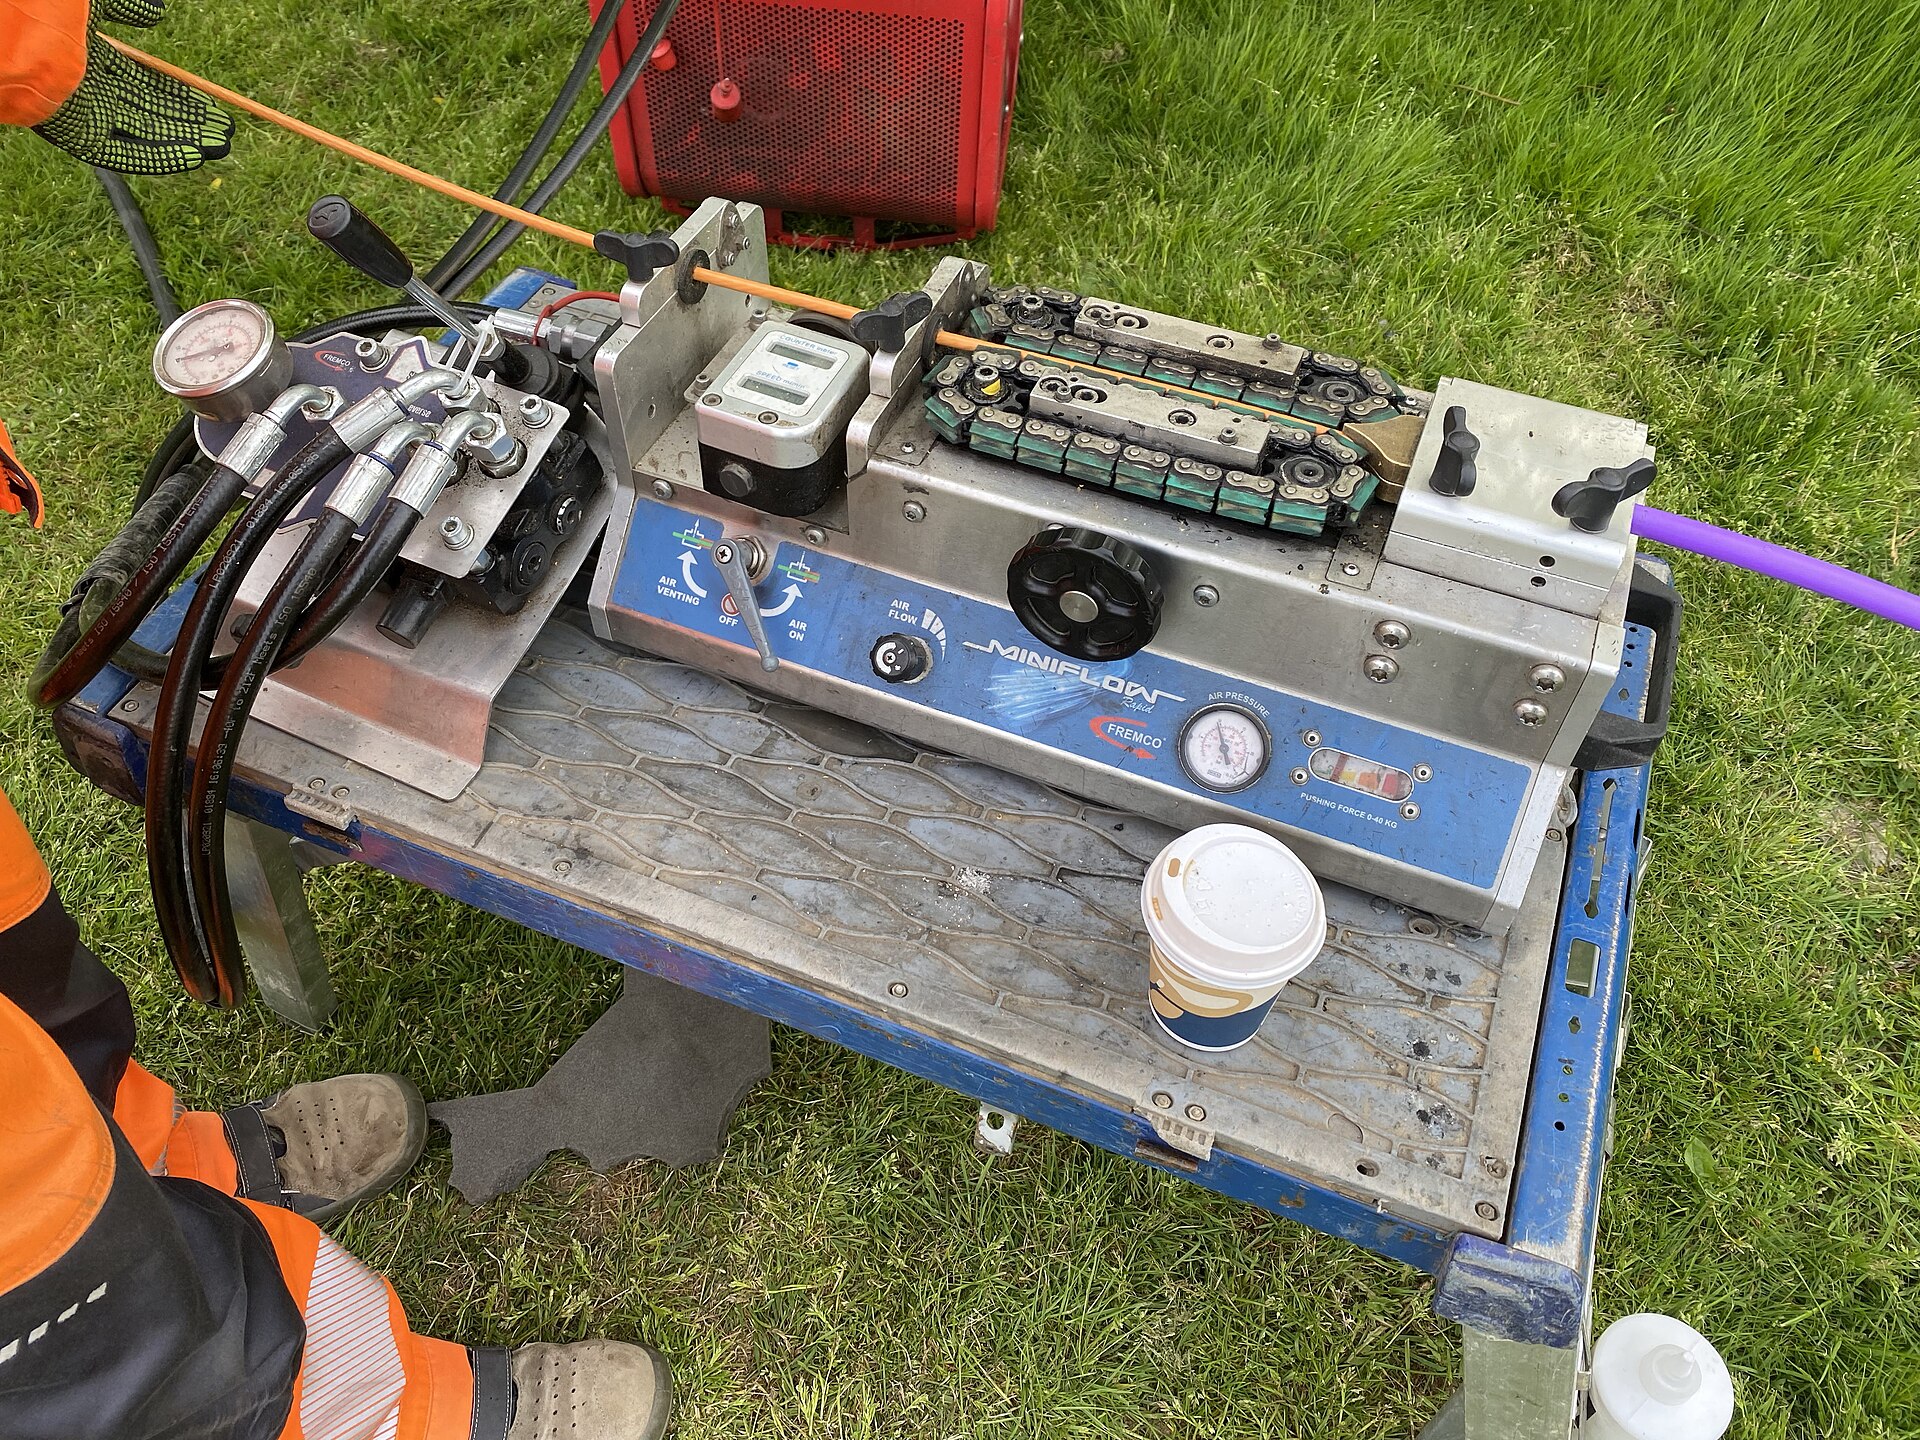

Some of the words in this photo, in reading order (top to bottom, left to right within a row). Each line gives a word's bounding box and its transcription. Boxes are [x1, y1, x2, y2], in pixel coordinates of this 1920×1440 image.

[779, 335, 815, 350] COUNTER
[322, 353, 352, 368] FREMCO
[755, 370, 782, 382] SPEED
[407, 404, 432, 418] everse
[142, 555, 159, 575] ISO
[658, 575, 678, 588] AIR
[656, 585, 700, 607] VENTING
[890, 598, 910, 612] AIR
[718, 615, 739, 627] OFF
[888, 609, 918, 625] FLOW
[788, 619, 808, 632] AIR
[254, 632, 278, 665] Meets
[277, 605, 293, 627] ISO
[788, 630, 806, 642] ON
[962, 638, 1187, 705] MINIFLOW
[1121, 695, 1156, 714] Rapid
[1207, 691, 1224, 701] AIR
[1225, 691, 1271, 718] PRESSURE
[1107, 723, 1163, 749] FREMCO
[1300, 792, 1337, 810] PUSHING
[1337, 804, 1366, 819] FORCE
[1366, 814, 1385, 826] 0-40
[1384, 819, 1399, 830] KG
